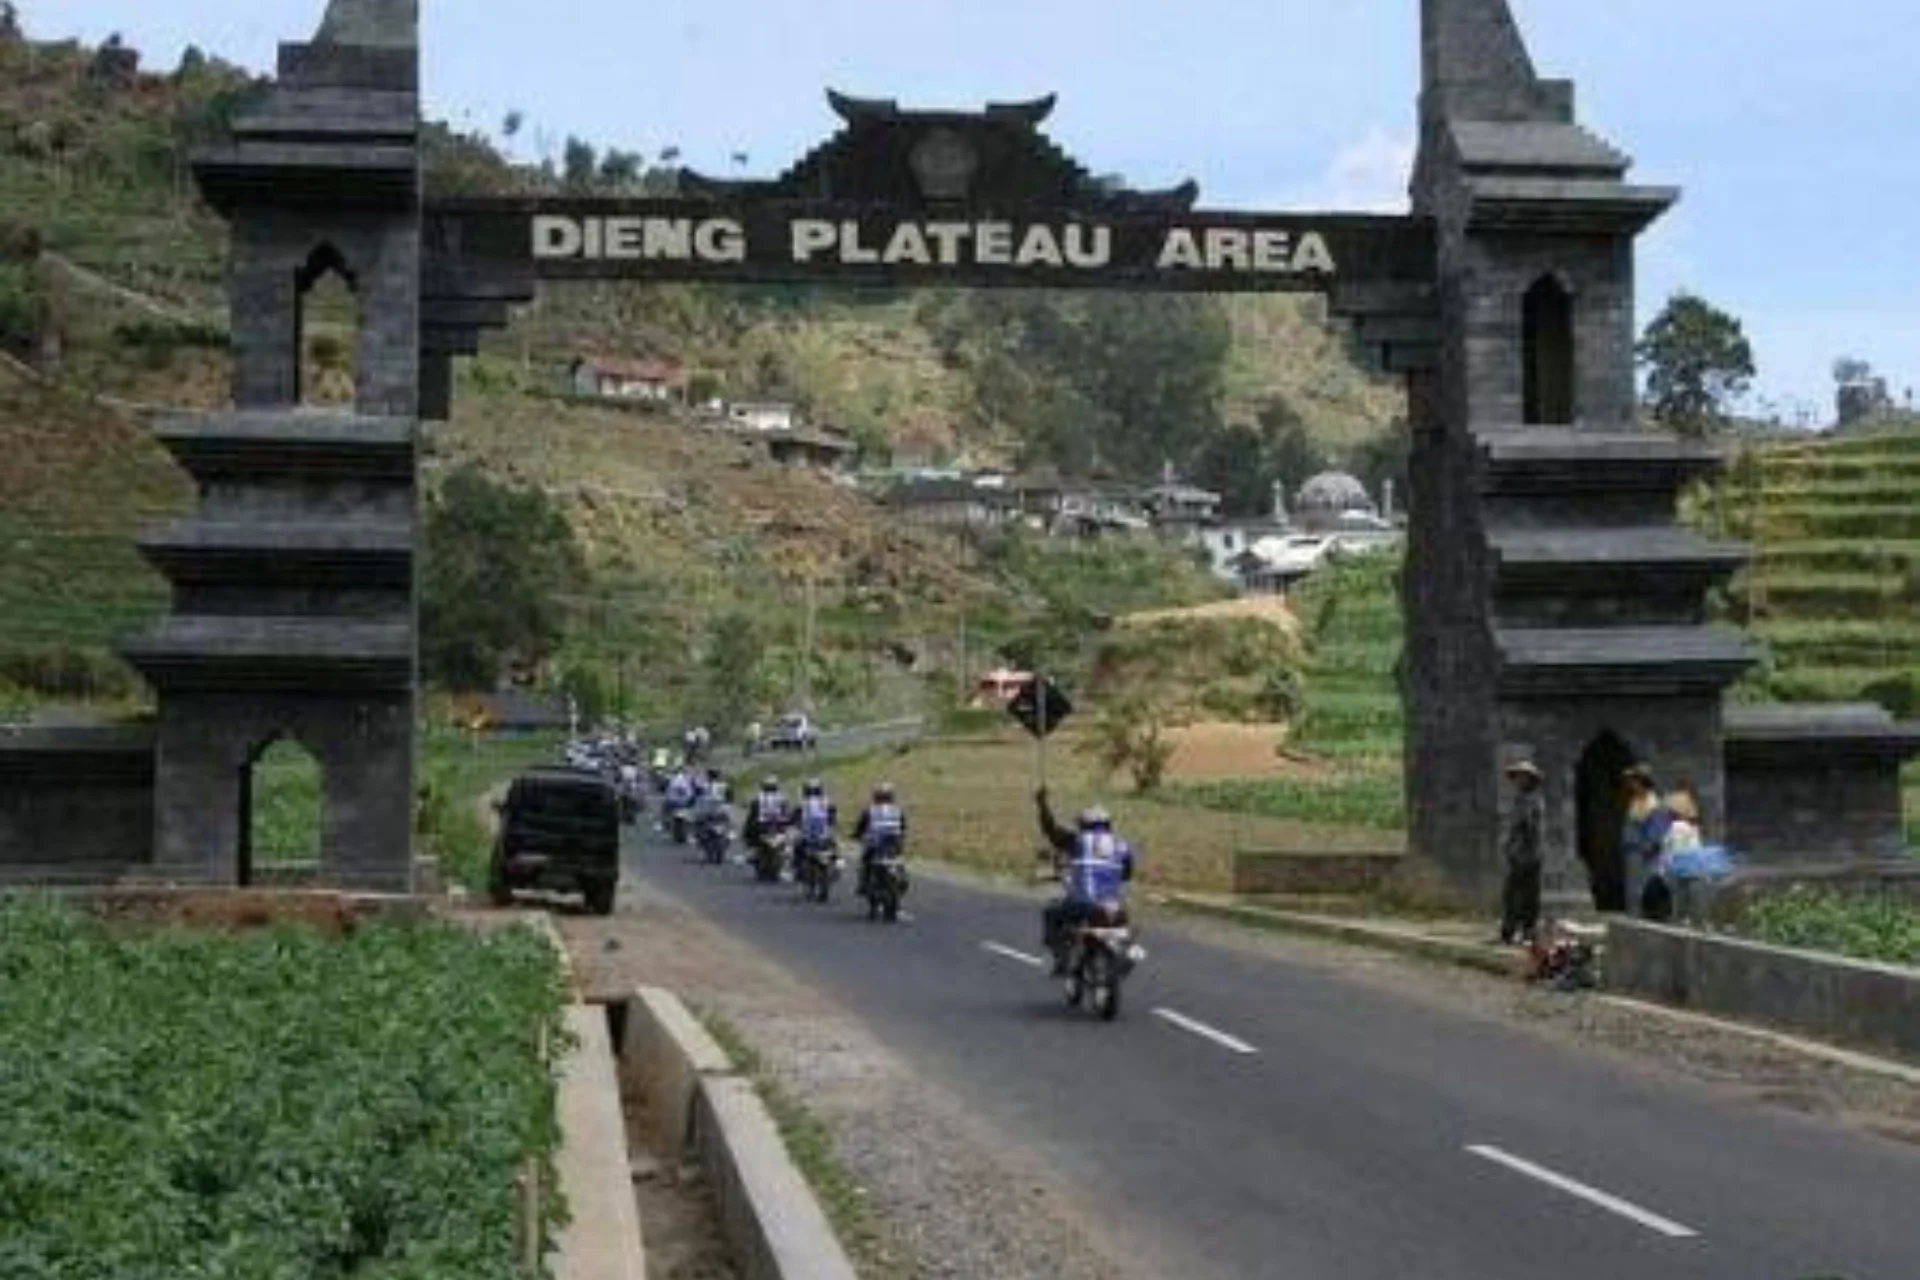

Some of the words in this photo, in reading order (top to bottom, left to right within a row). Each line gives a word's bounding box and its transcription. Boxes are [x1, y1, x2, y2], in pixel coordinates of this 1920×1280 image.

[532, 216, 746, 263] DIENG
[791, 219, 1111, 267] PLATEAU
[1156, 227, 1335, 273] AREA
